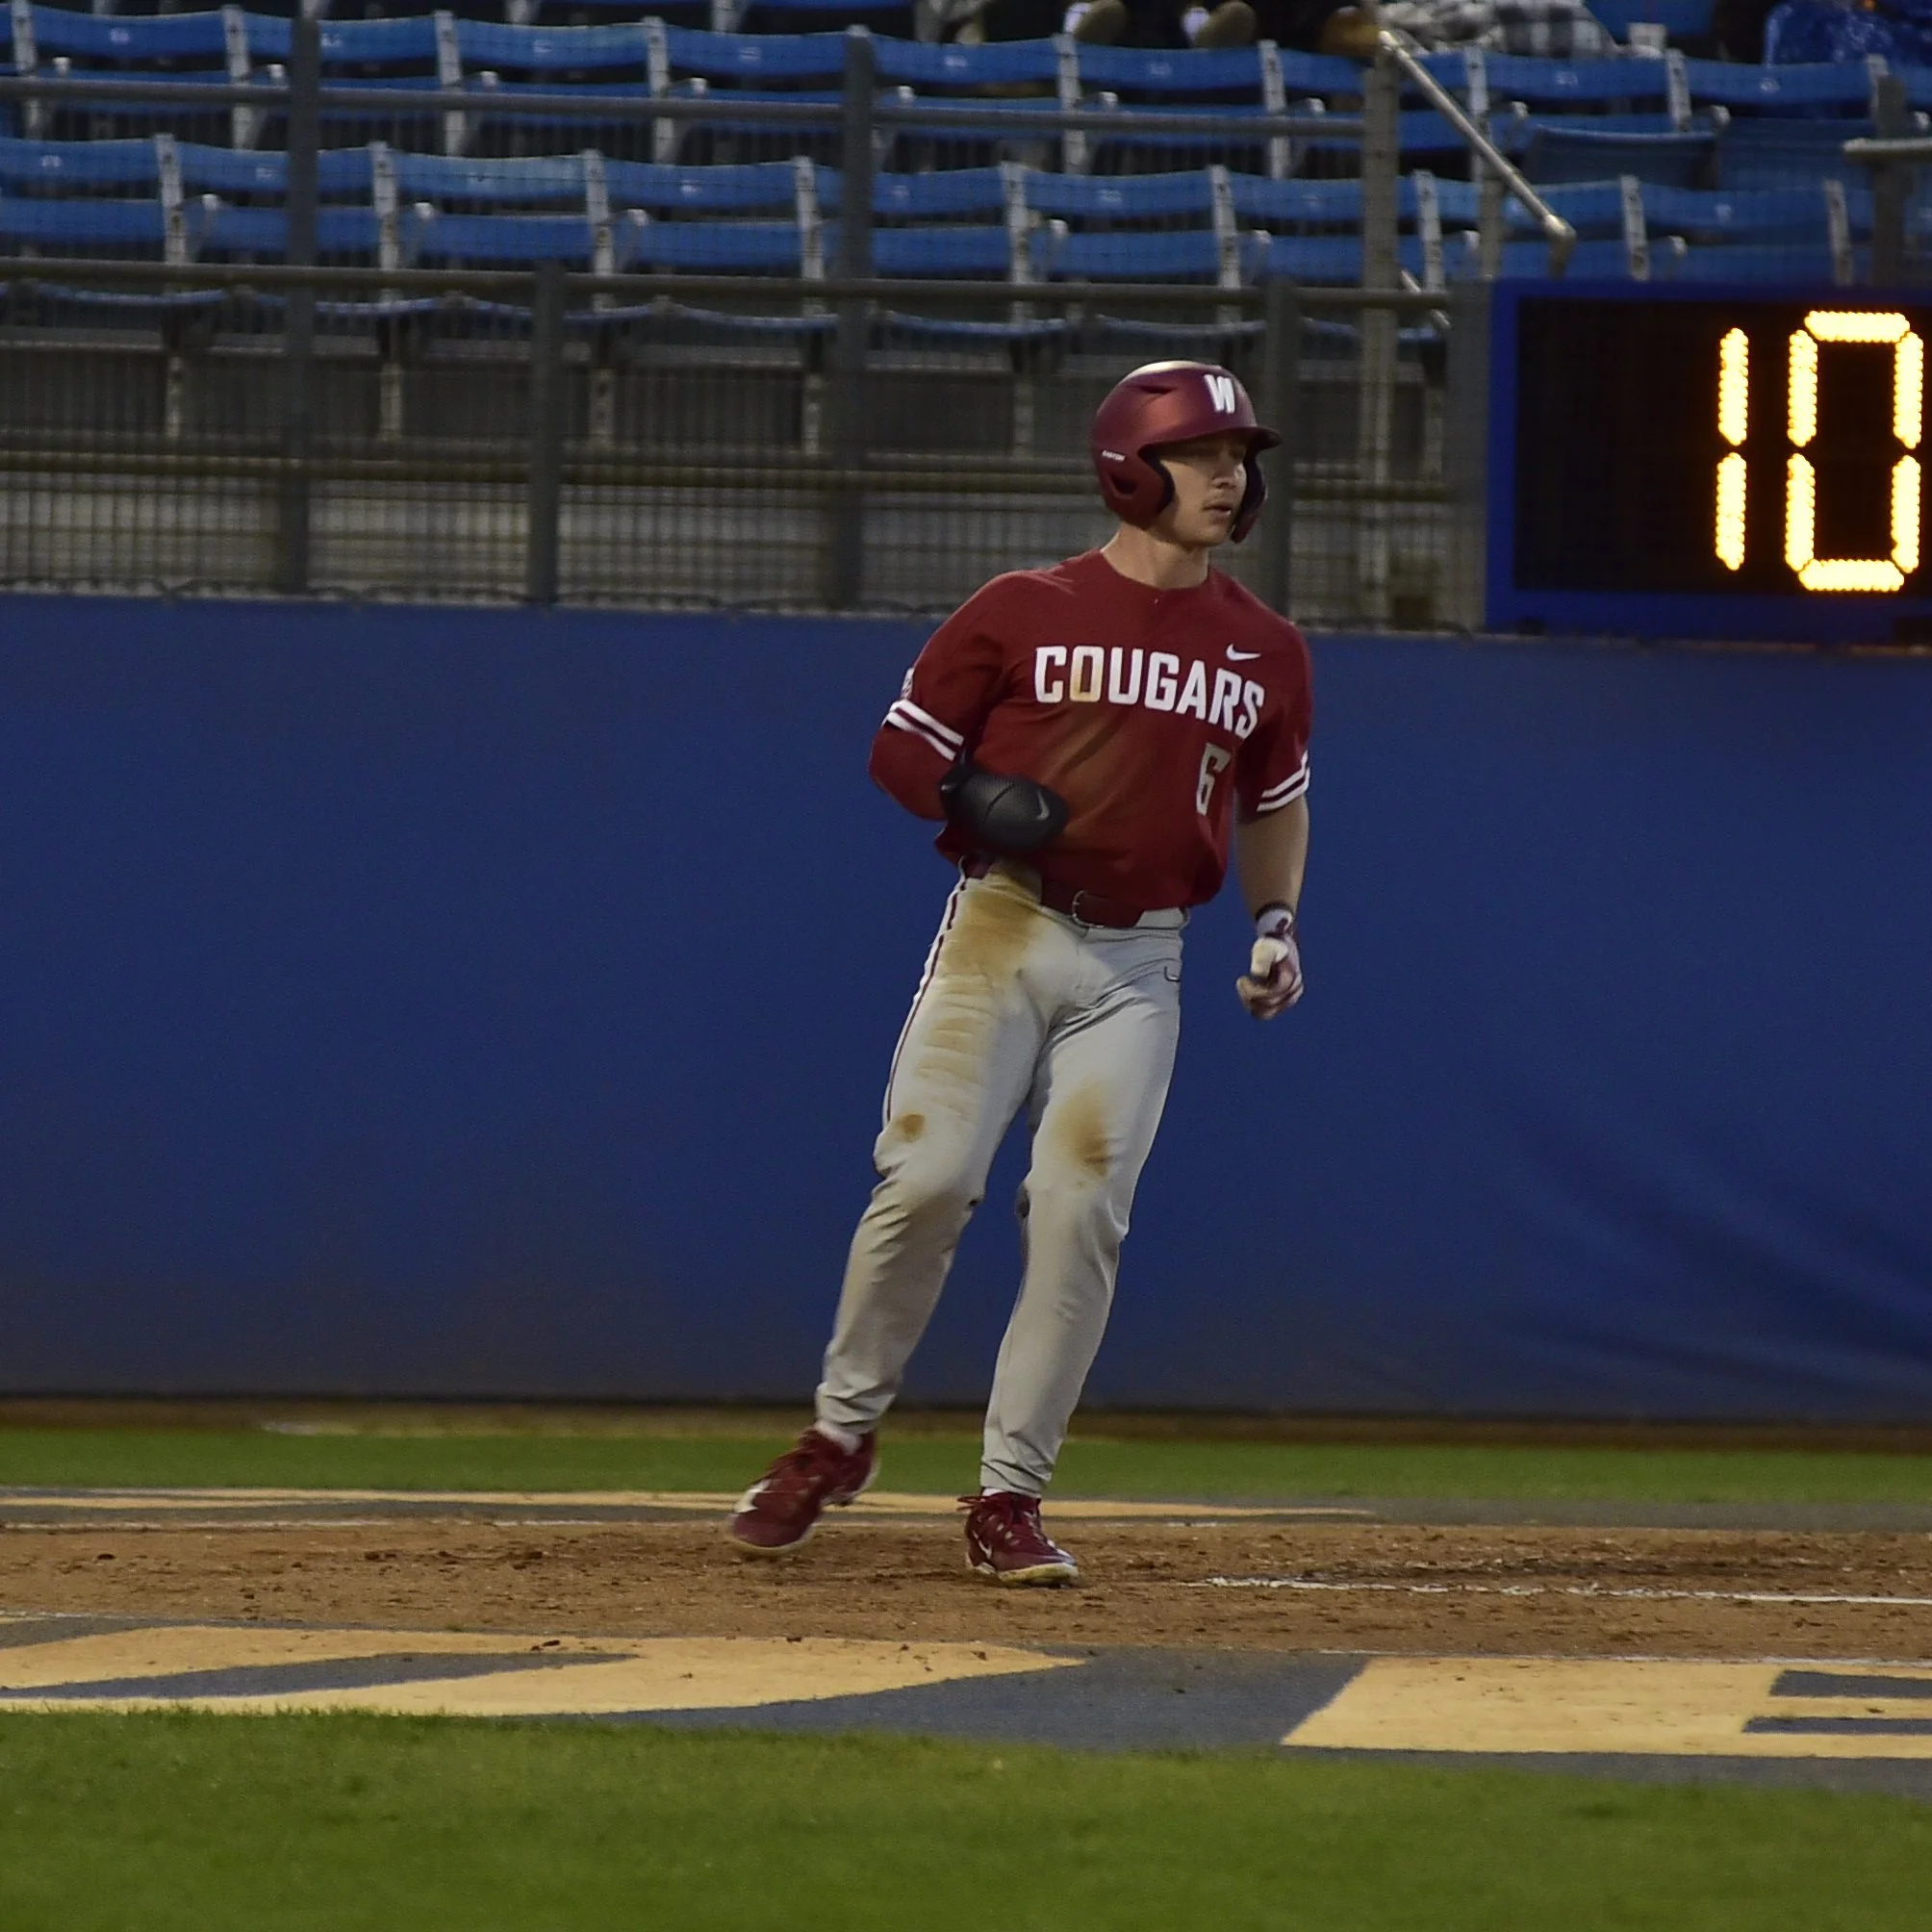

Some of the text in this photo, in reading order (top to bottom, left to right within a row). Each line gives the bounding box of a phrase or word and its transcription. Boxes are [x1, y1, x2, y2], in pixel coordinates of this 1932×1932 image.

[1204, 373, 1235, 414] W
[1716, 310, 1923, 591] 10
[1034, 646, 1265, 739] COUGARS
[1196, 742, 1232, 816] 6
